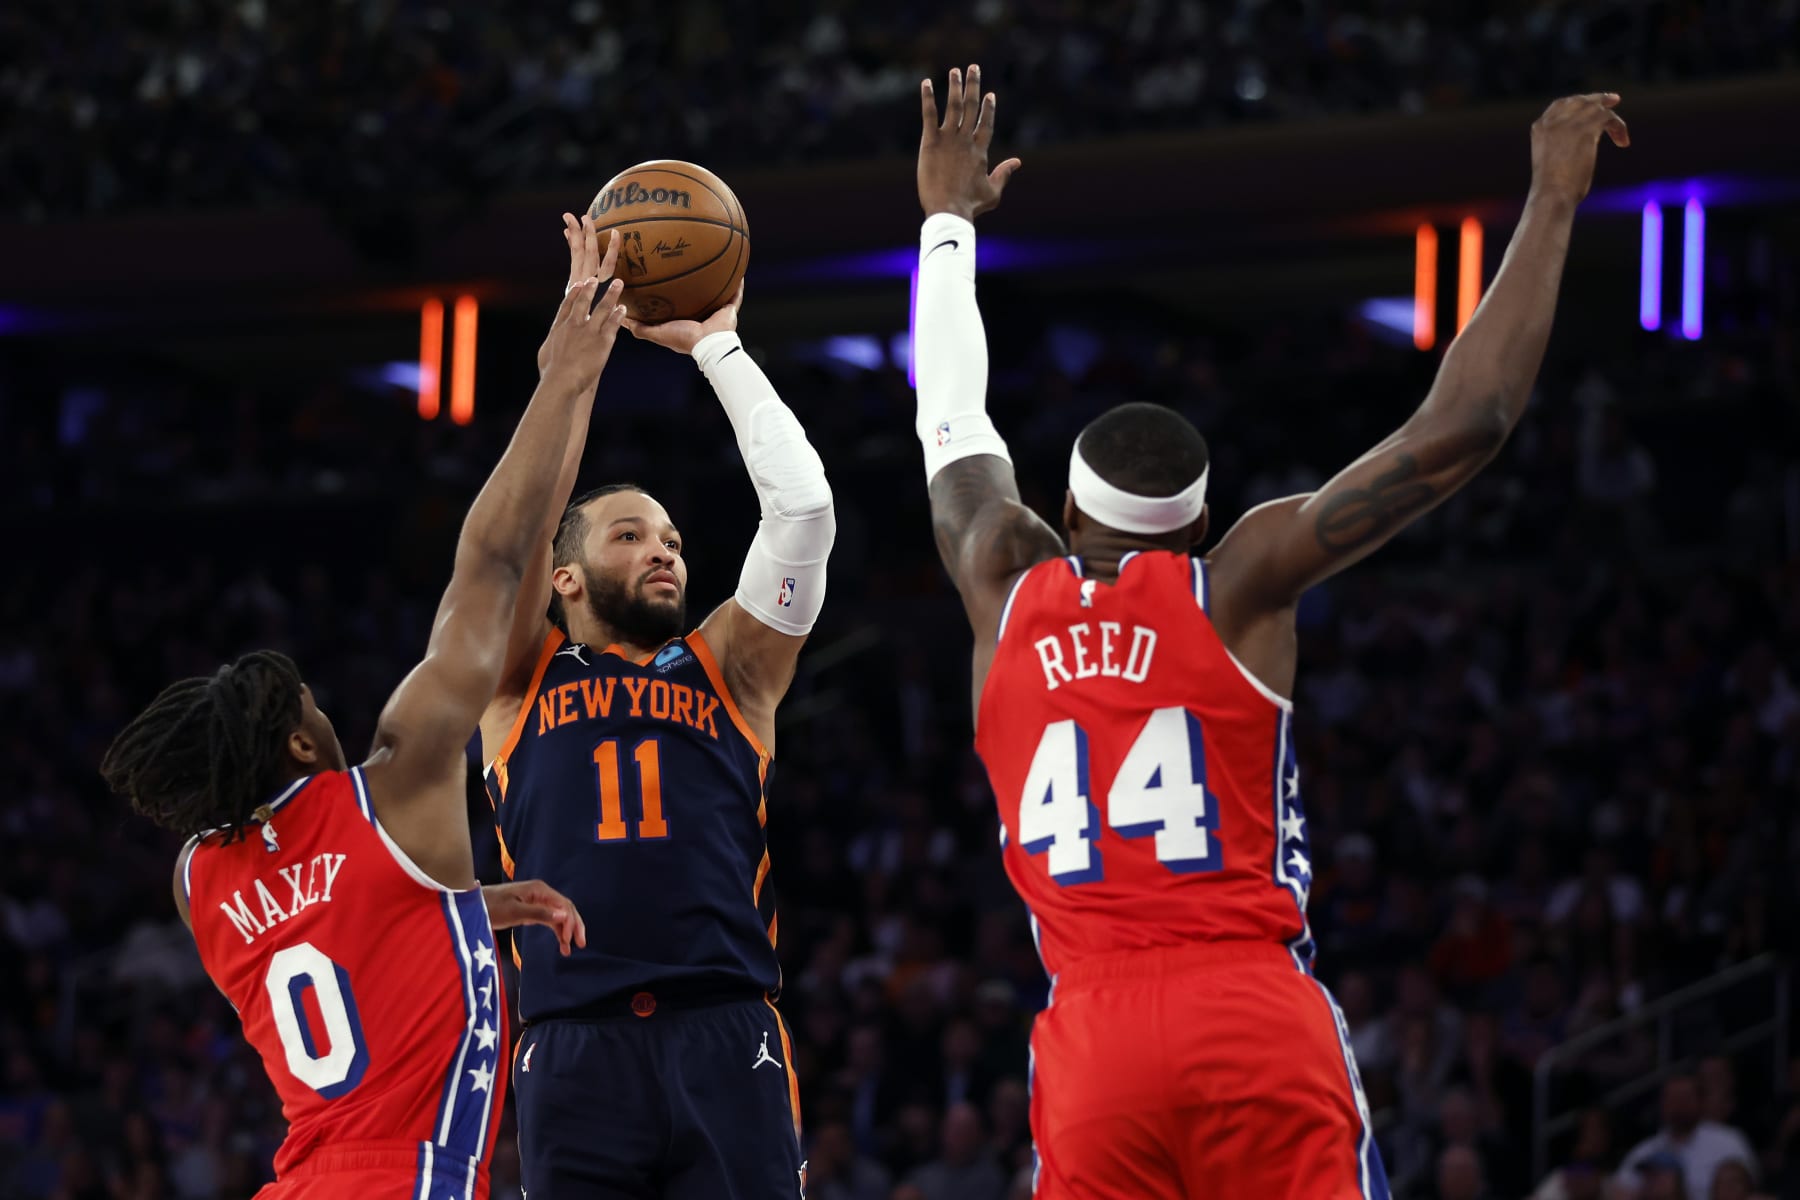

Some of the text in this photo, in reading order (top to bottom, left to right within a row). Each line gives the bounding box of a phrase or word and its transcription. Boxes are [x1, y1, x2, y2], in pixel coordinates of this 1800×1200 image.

[1034, 621, 1157, 691] REED
[537, 676, 720, 740] NEW YORK
[592, 738, 669, 841] 11
[1018, 705, 1222, 886] 44
[219, 852, 347, 945] MAXEY
[265, 941, 368, 1099] 0
